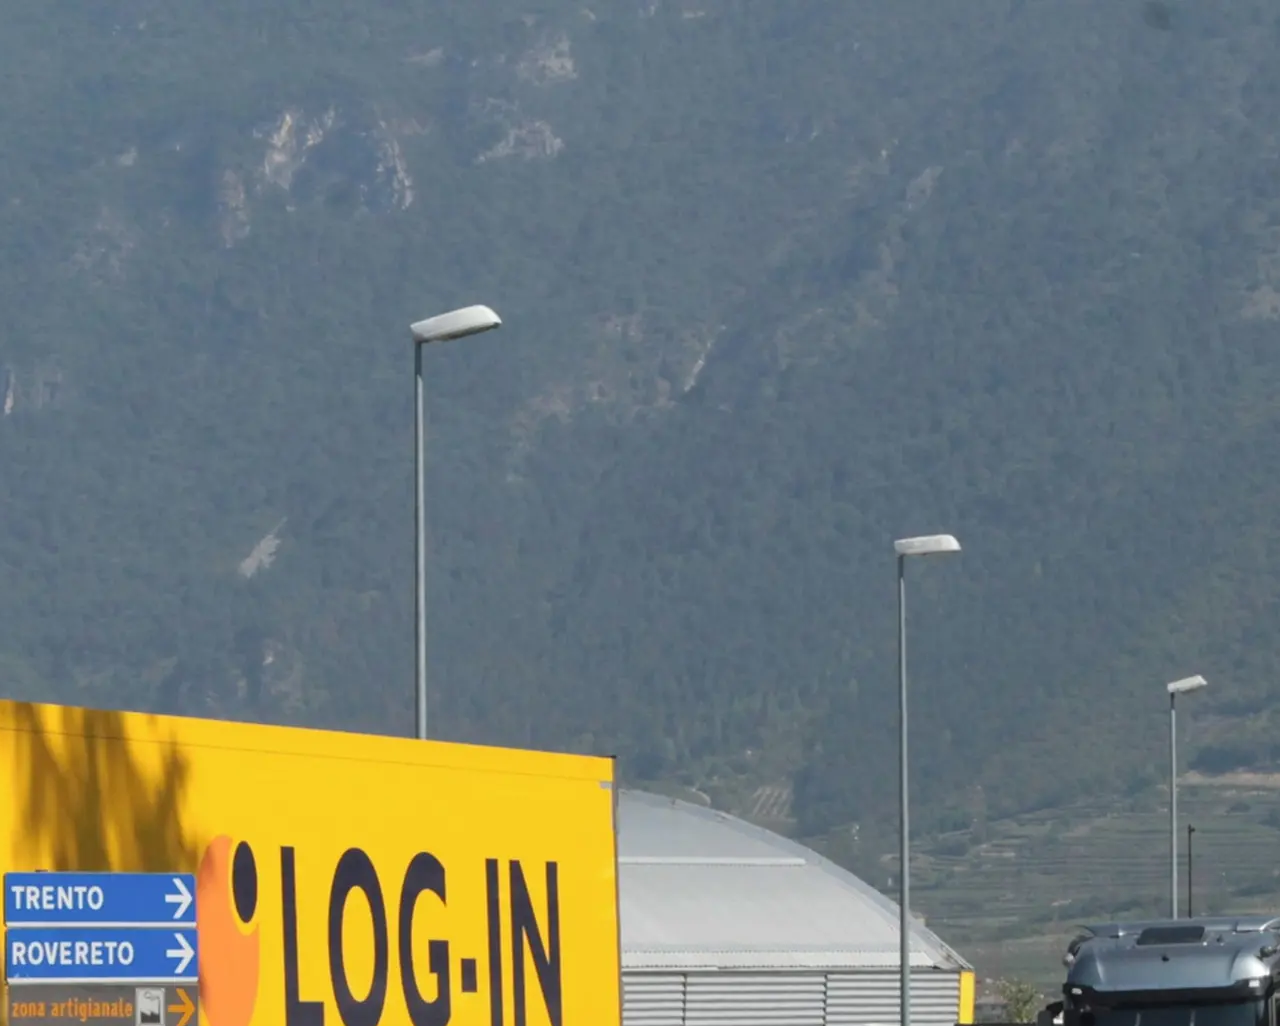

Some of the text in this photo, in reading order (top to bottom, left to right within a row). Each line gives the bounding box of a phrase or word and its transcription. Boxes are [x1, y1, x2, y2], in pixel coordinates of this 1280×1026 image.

[10, 885, 104, 911] TRENTO
[11, 940, 134, 966] ROVERETO
[11, 997, 133, 1023] zona artigianale
